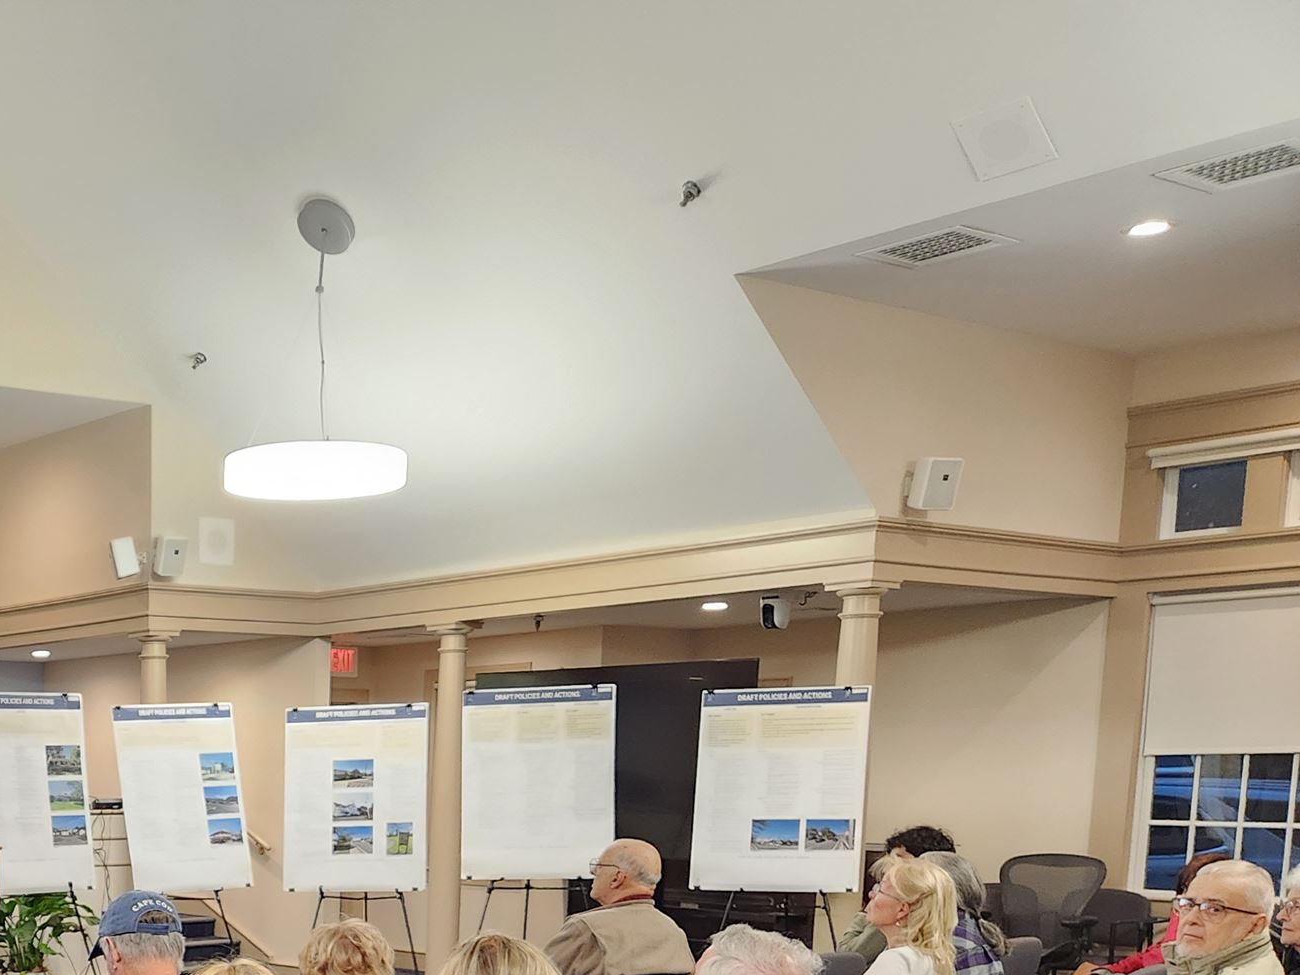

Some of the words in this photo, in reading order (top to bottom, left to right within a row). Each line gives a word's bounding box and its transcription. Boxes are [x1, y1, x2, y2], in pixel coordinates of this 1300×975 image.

[331, 648, 356, 673] EXIT
[494, 692, 514, 701] DRAFT
[514, 692, 540, 700] POLICIES
[541, 691, 554, 699] AND
[554, 690, 580, 698] ACTIONS
[737, 693, 758, 702] DRAFT
[759, 693, 787, 701] POLICIES
[788, 692, 802, 700] AND
[803, 691, 832, 699] ACTIONS
[131, 899, 155, 912] CAPE
